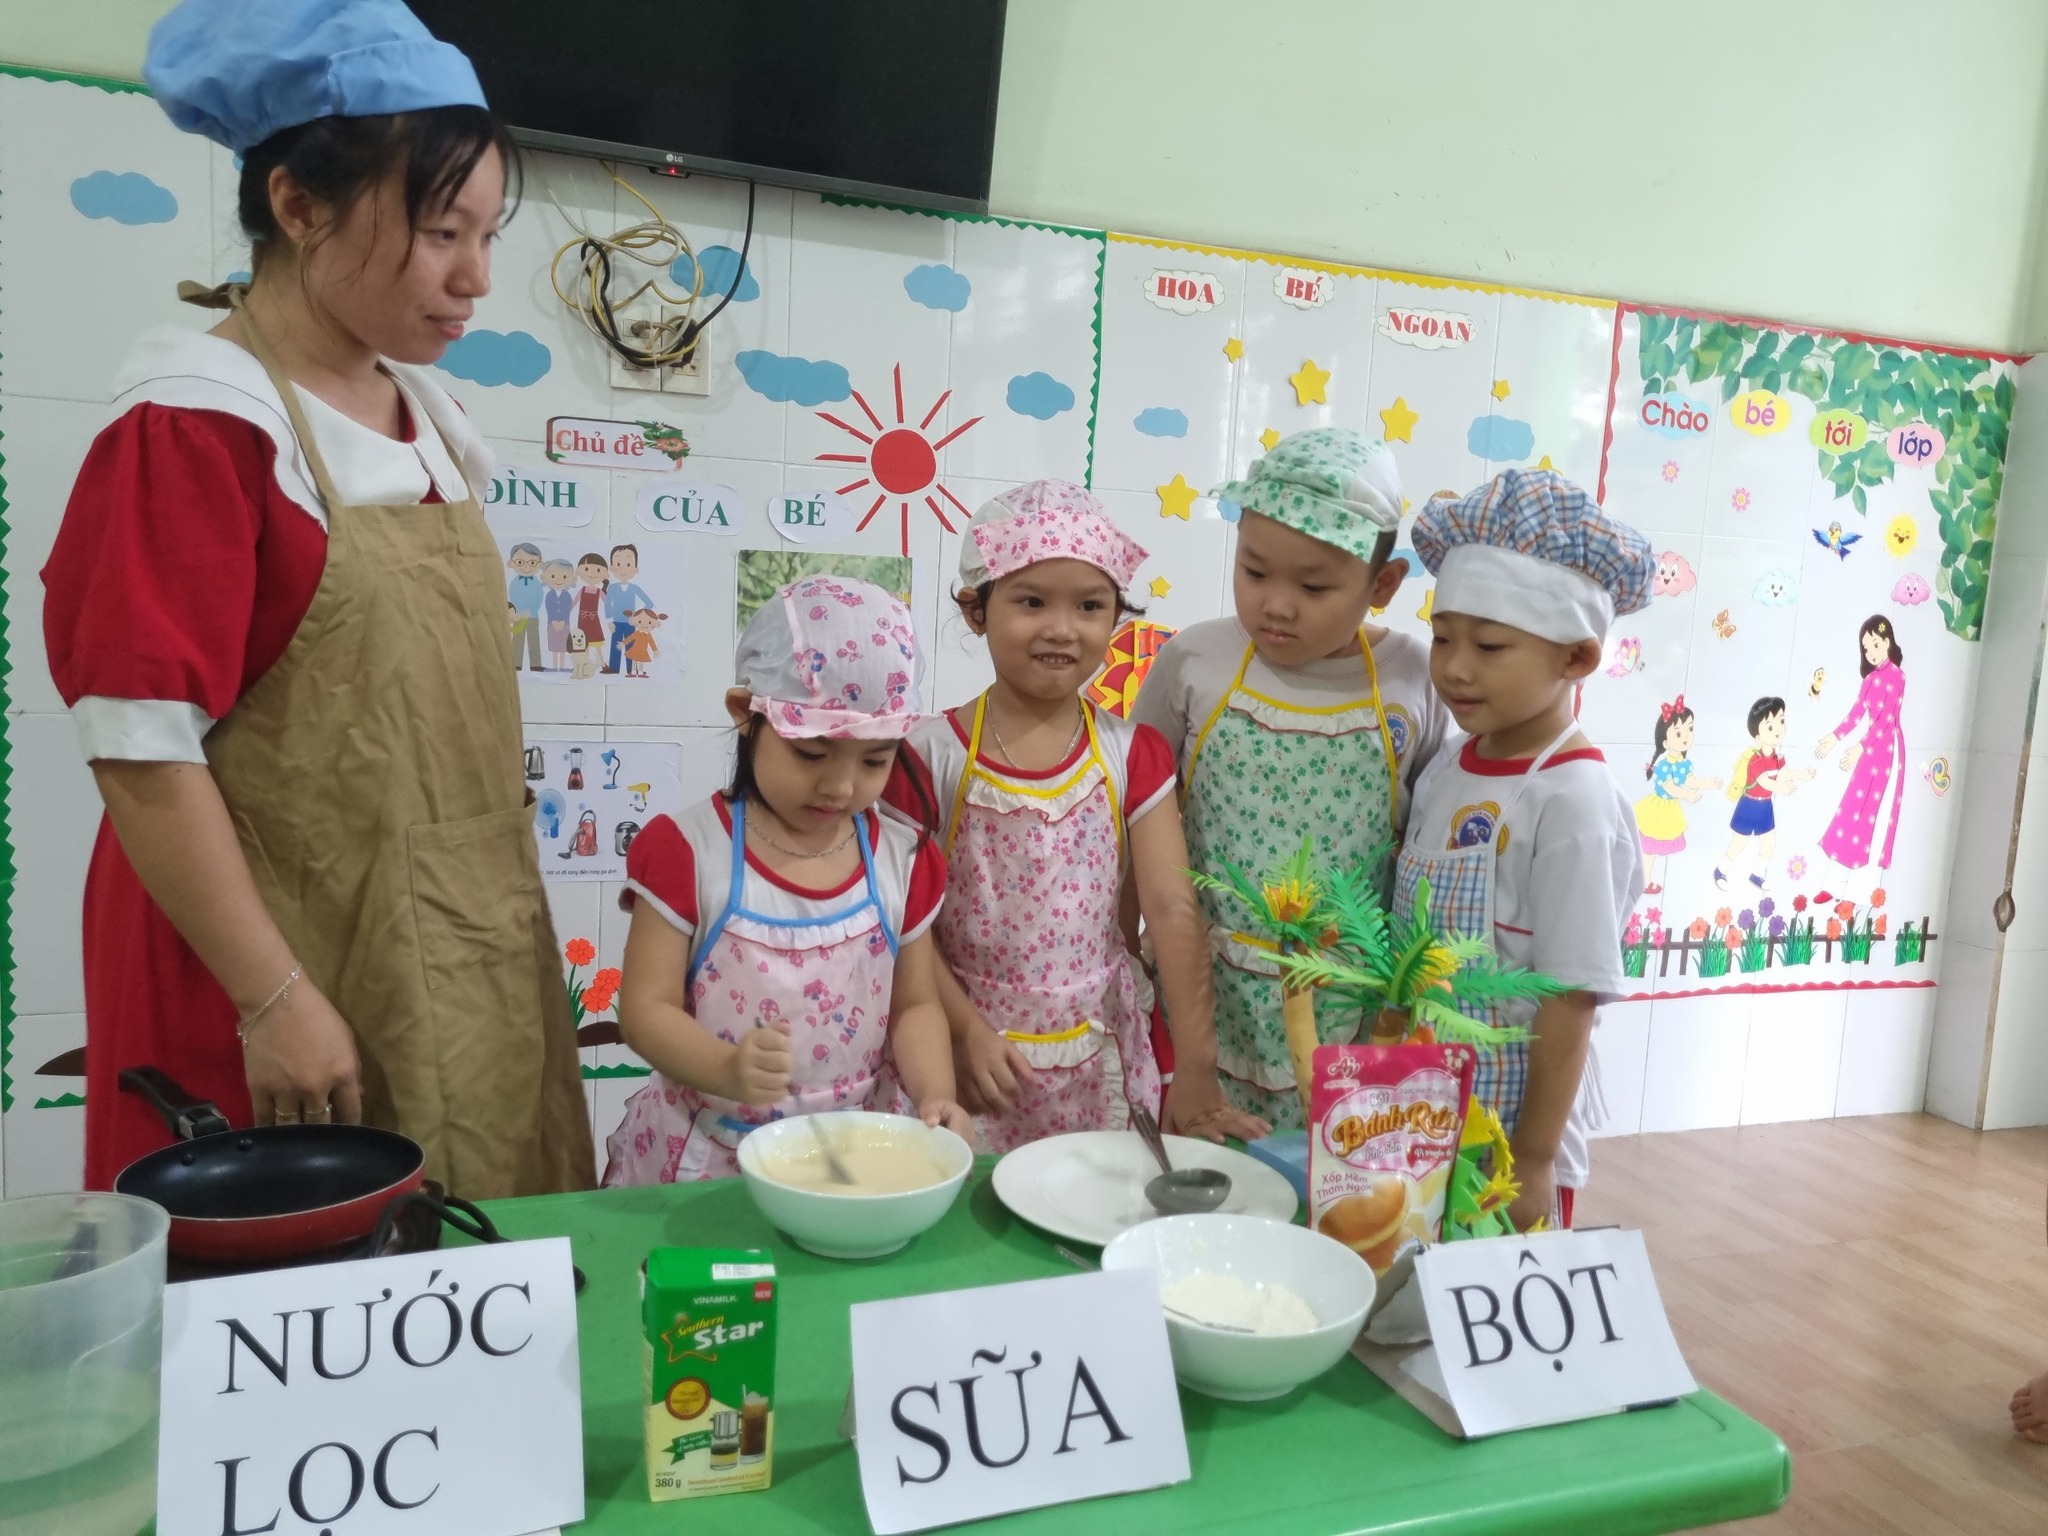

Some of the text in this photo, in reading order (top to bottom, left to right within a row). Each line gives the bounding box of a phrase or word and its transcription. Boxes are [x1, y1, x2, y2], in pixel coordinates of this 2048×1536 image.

[674, 155, 683, 163] LG
[1155, 275, 1473, 343] HOA BÉ NGOAN
[555, 429, 645, 457] Chủ đề
[1641, 398, 1933, 461] Chào bé tới lớp
[484, 469, 827, 527] ĐÌNH CỦA BÉ
[1331, 1104, 1404, 1159] Bánh
[1316, 1182, 1372, 1200] Thơm Ngon
[1321, 1170, 1368, 1185] Xốp Mềm
[693, 1294, 737, 1305] VINAMILK
[754, 1289, 772, 1299] NEW
[678, 1315, 725, 1338] Southern
[1445, 1249, 1624, 1373] BỘT
[215, 1269, 534, 1396] NƯỚC
[694, 1320, 764, 1351] Star
[890, 1344, 1134, 1488] SỮA
[214, 1424, 441, 1536] LỌC
[655, 1477, 674, 1488] 380
[676, 1478, 682, 1489] g
